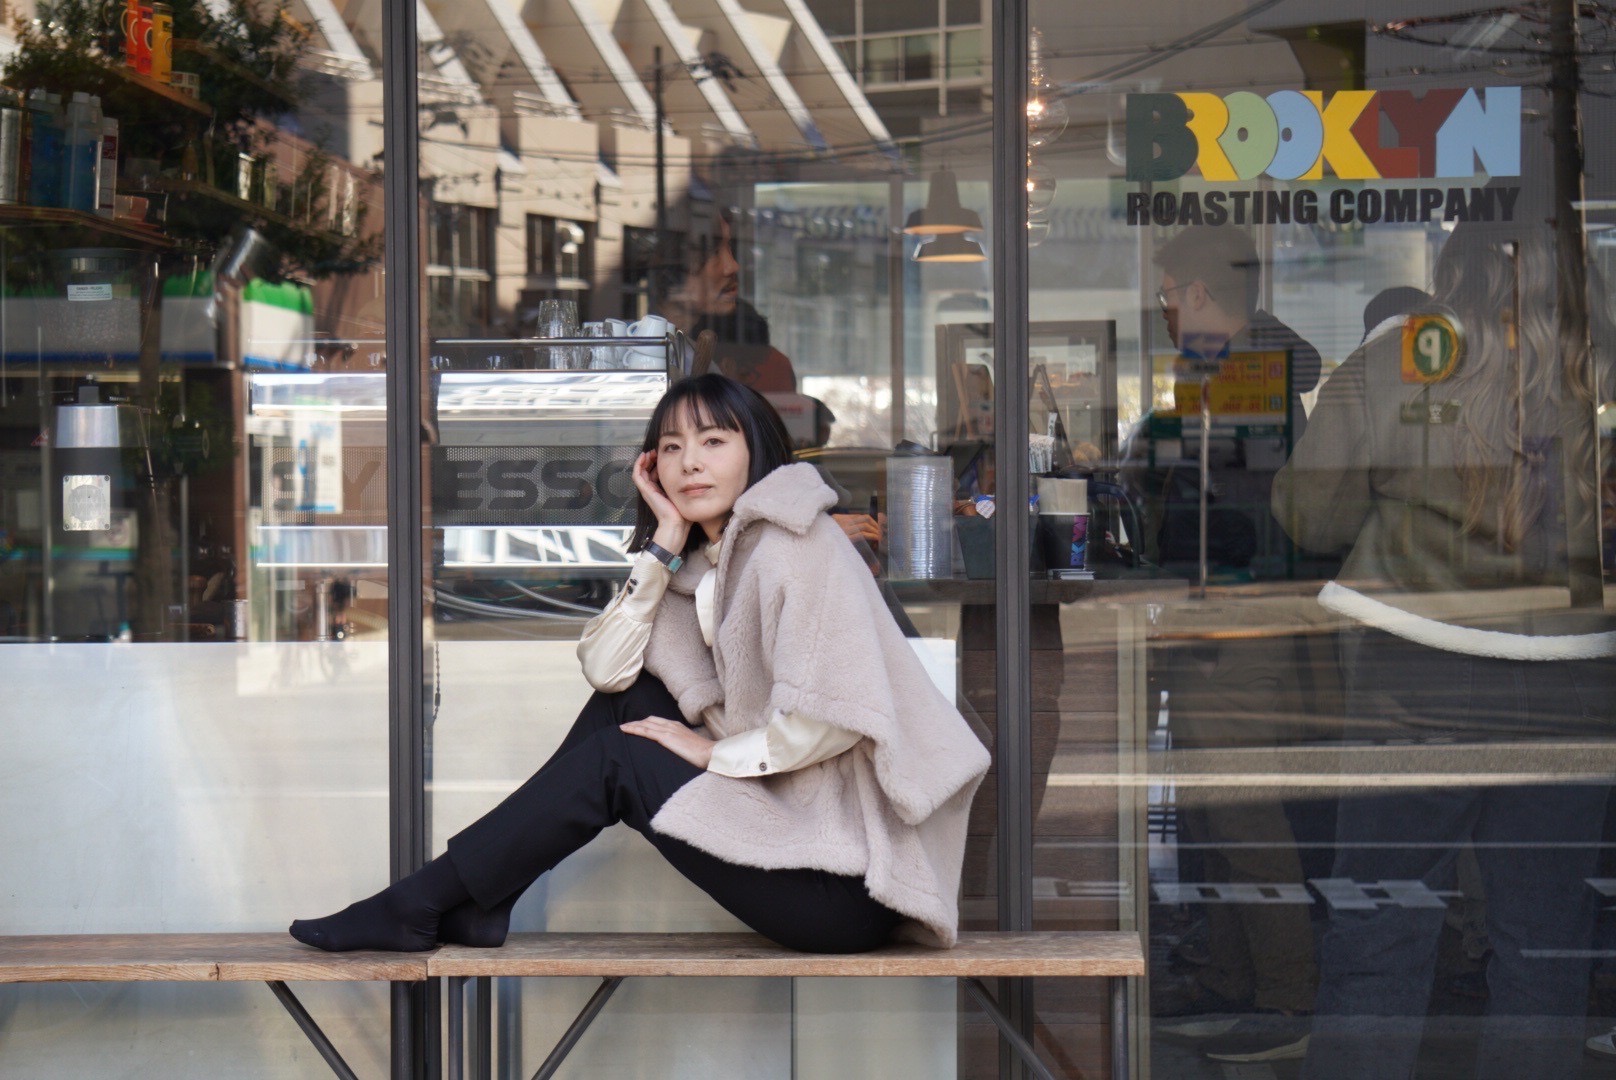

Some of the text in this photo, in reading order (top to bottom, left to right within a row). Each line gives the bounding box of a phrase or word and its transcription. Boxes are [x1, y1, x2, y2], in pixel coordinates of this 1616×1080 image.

[1126, 86, 1521, 182] BROOKLYN
[1126, 187, 1521, 226] ROASTING COMPANY
